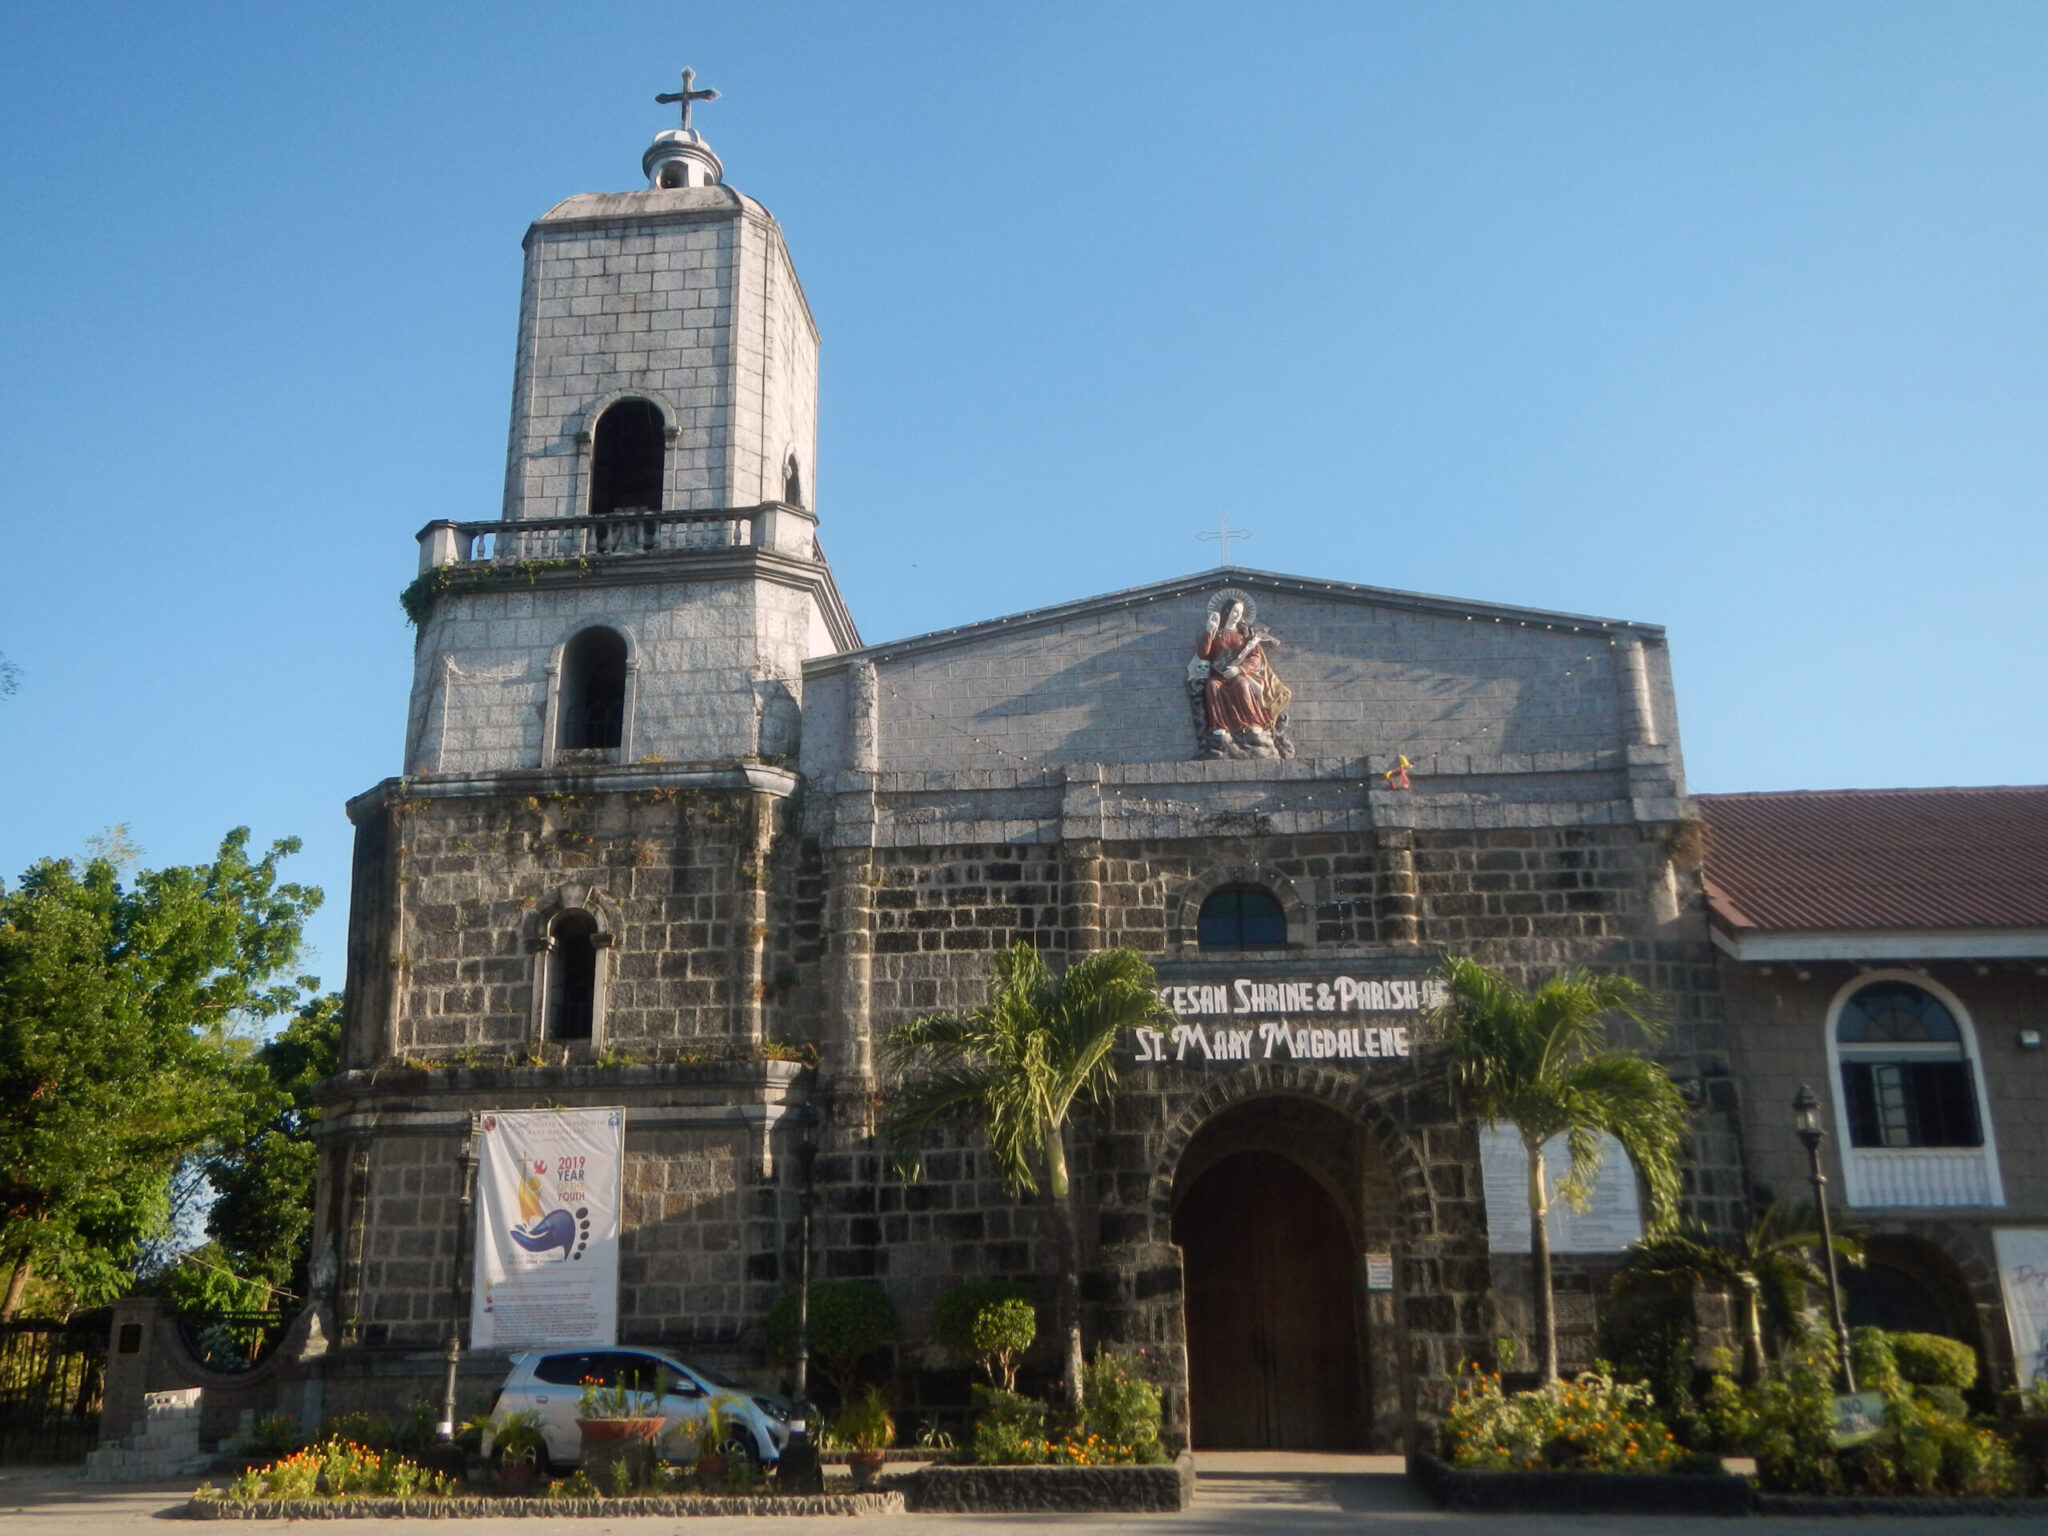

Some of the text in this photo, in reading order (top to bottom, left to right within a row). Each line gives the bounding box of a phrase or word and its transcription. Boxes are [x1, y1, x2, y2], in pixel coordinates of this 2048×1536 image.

[1152, 985, 1228, 1014] CESAN
[1234, 979, 1313, 1013] SHRINE
[1316, 983, 1335, 1011] &
[1334, 976, 1418, 1012] PARISH
[1135, 1020, 1409, 1061] ST. MARY MAGDALENE
[558, 1156, 586, 1170] 2019
[557, 1169, 585, 1182] YEAR
[557, 1191, 585, 1202] YOUTH
